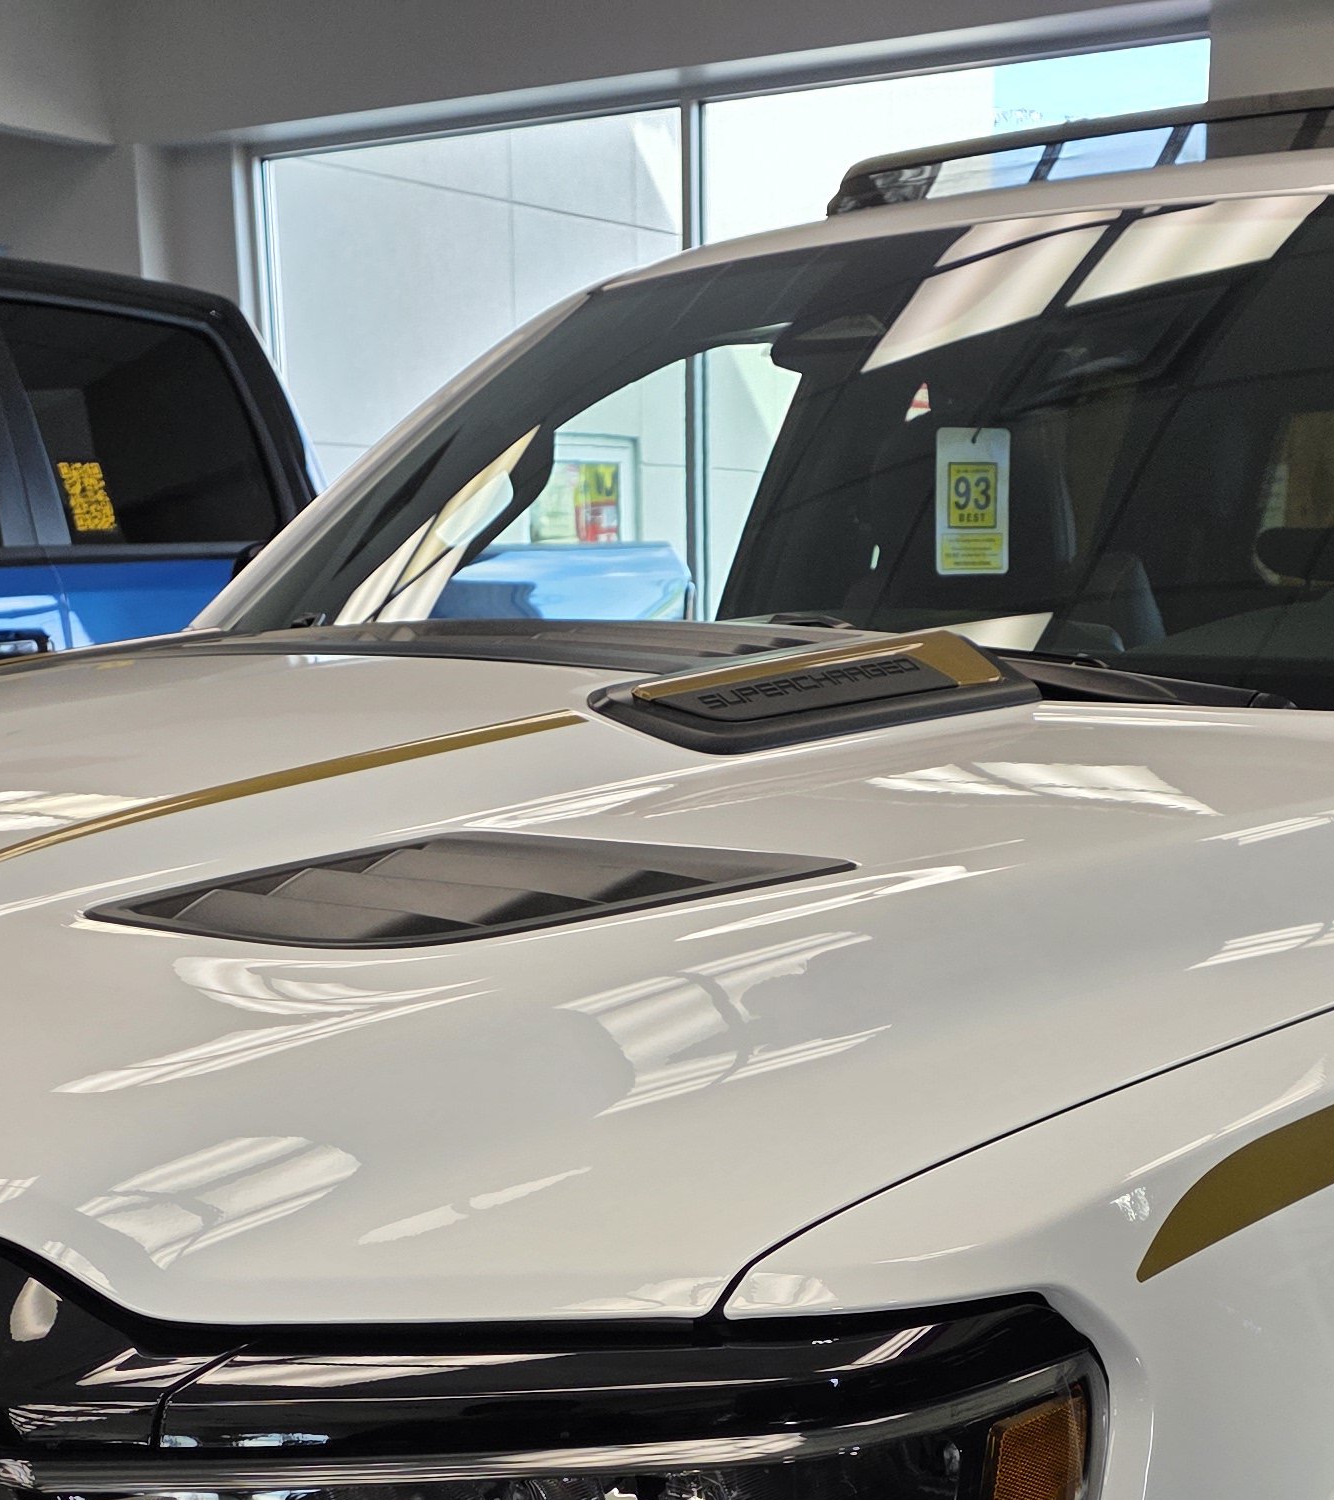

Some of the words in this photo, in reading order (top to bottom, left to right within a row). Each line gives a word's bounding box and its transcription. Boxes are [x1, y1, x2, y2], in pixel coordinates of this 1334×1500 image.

[954, 476, 992, 511] 93
[958, 513, 986, 523] BEST
[697, 658, 921, 710] SUPERCHARGED
